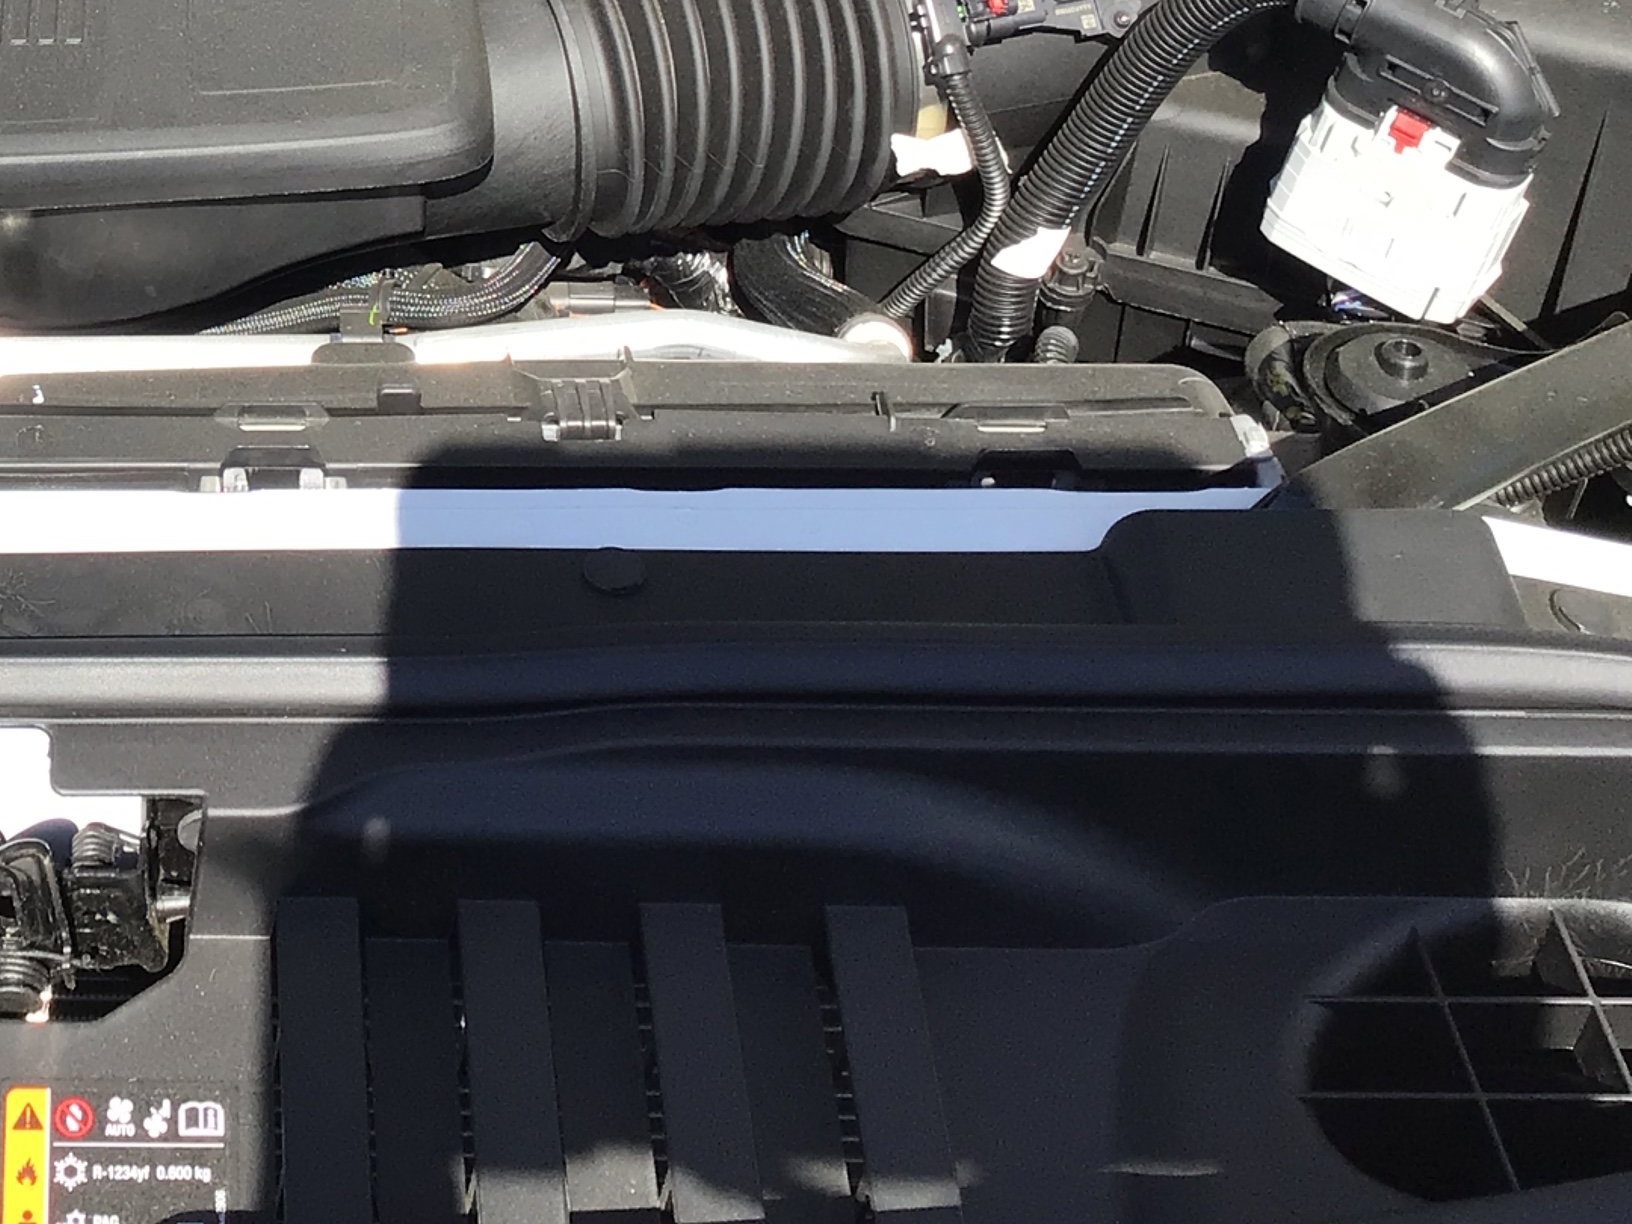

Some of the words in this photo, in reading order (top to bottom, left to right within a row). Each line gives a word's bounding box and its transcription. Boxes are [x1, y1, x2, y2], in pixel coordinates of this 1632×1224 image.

[105, 1122, 136, 1137] AUTO
[92, 1163, 150, 1183] R-1234yf
[194, 1164, 212, 1183] kg
